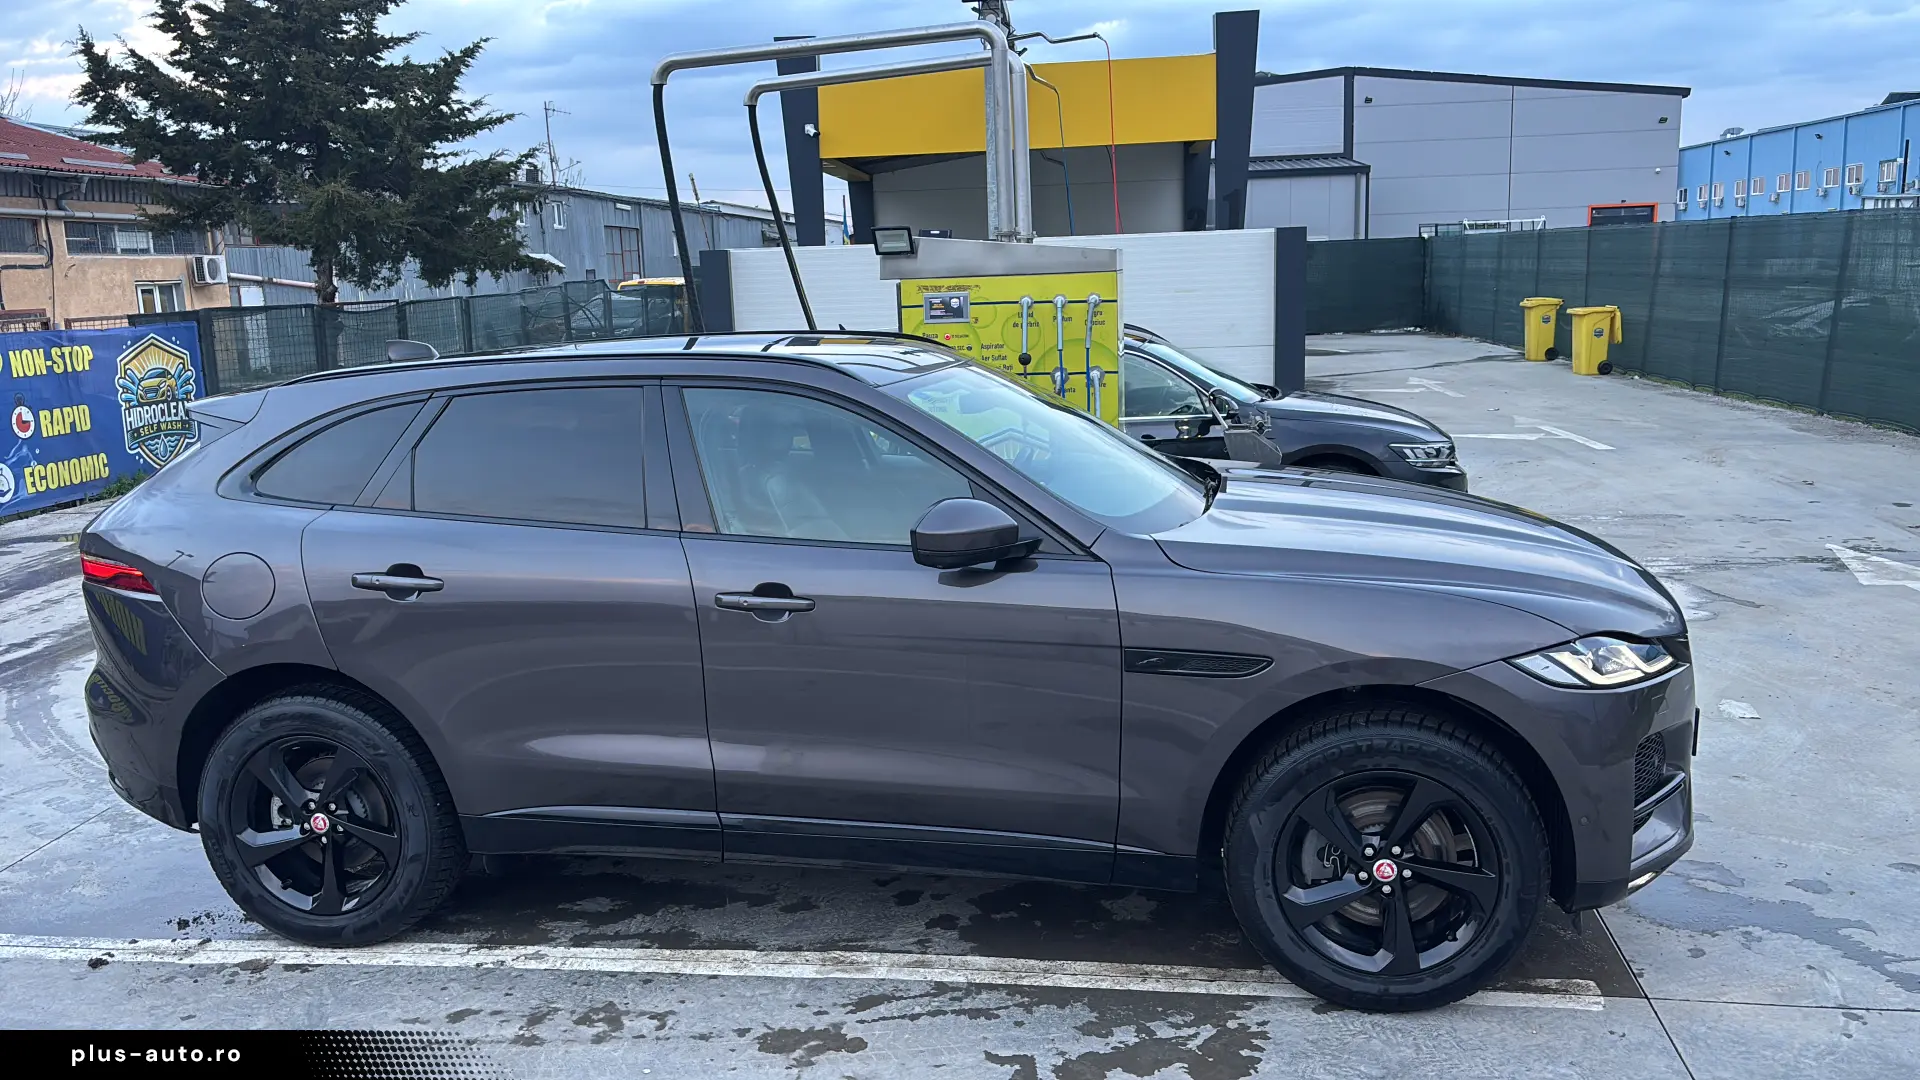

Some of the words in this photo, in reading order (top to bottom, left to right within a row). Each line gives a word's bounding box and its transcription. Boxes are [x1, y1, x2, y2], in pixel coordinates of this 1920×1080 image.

[8, 345, 94, 378] NON-STOP
[39, 404, 91, 438] RAPID
[140, 424, 158, 436] SELF
[160, 421, 182, 431] WASH
[24, 453, 110, 495] ECONOMIC
